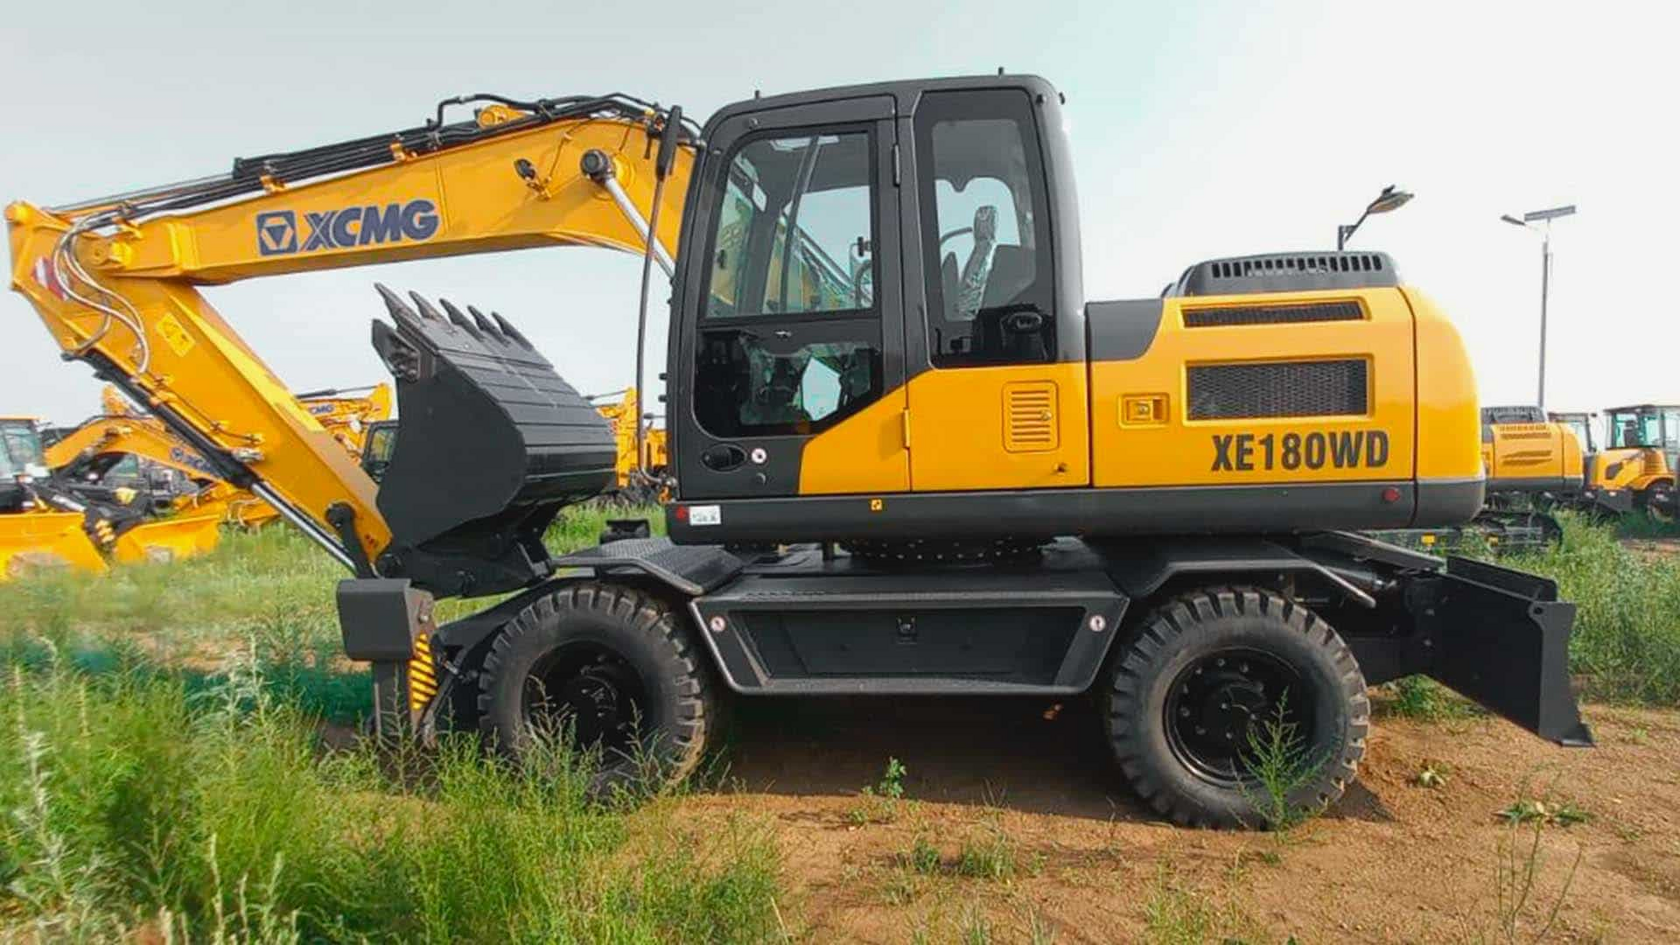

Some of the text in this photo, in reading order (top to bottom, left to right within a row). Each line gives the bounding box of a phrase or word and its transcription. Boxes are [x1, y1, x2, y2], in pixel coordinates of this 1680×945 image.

[301, 199, 439, 251] XCMG
[308, 403, 334, 415] CMG
[1211, 430, 1389, 471] XE180WD
